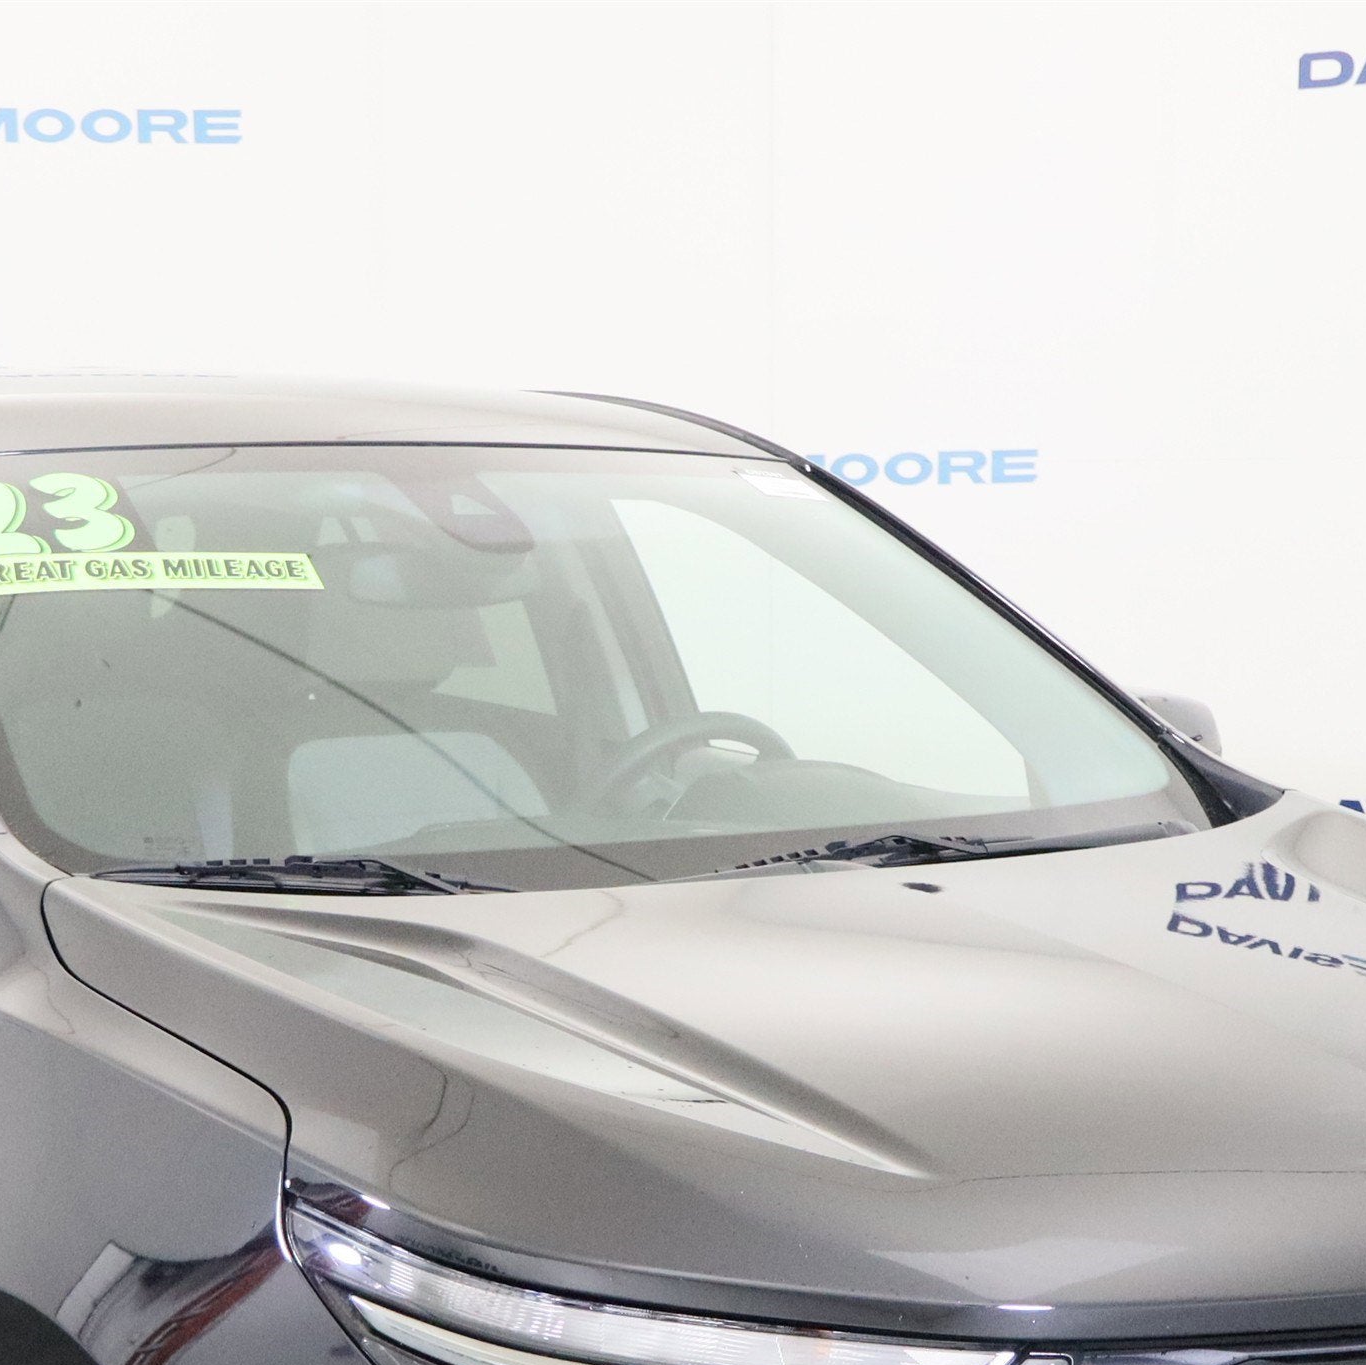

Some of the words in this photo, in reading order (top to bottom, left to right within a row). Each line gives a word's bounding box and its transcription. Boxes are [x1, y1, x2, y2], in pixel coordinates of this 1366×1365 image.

[805, 449, 1039, 487] OORE
[85, 558, 153, 581] GAS
[162, 557, 309, 581] MILEAGE
